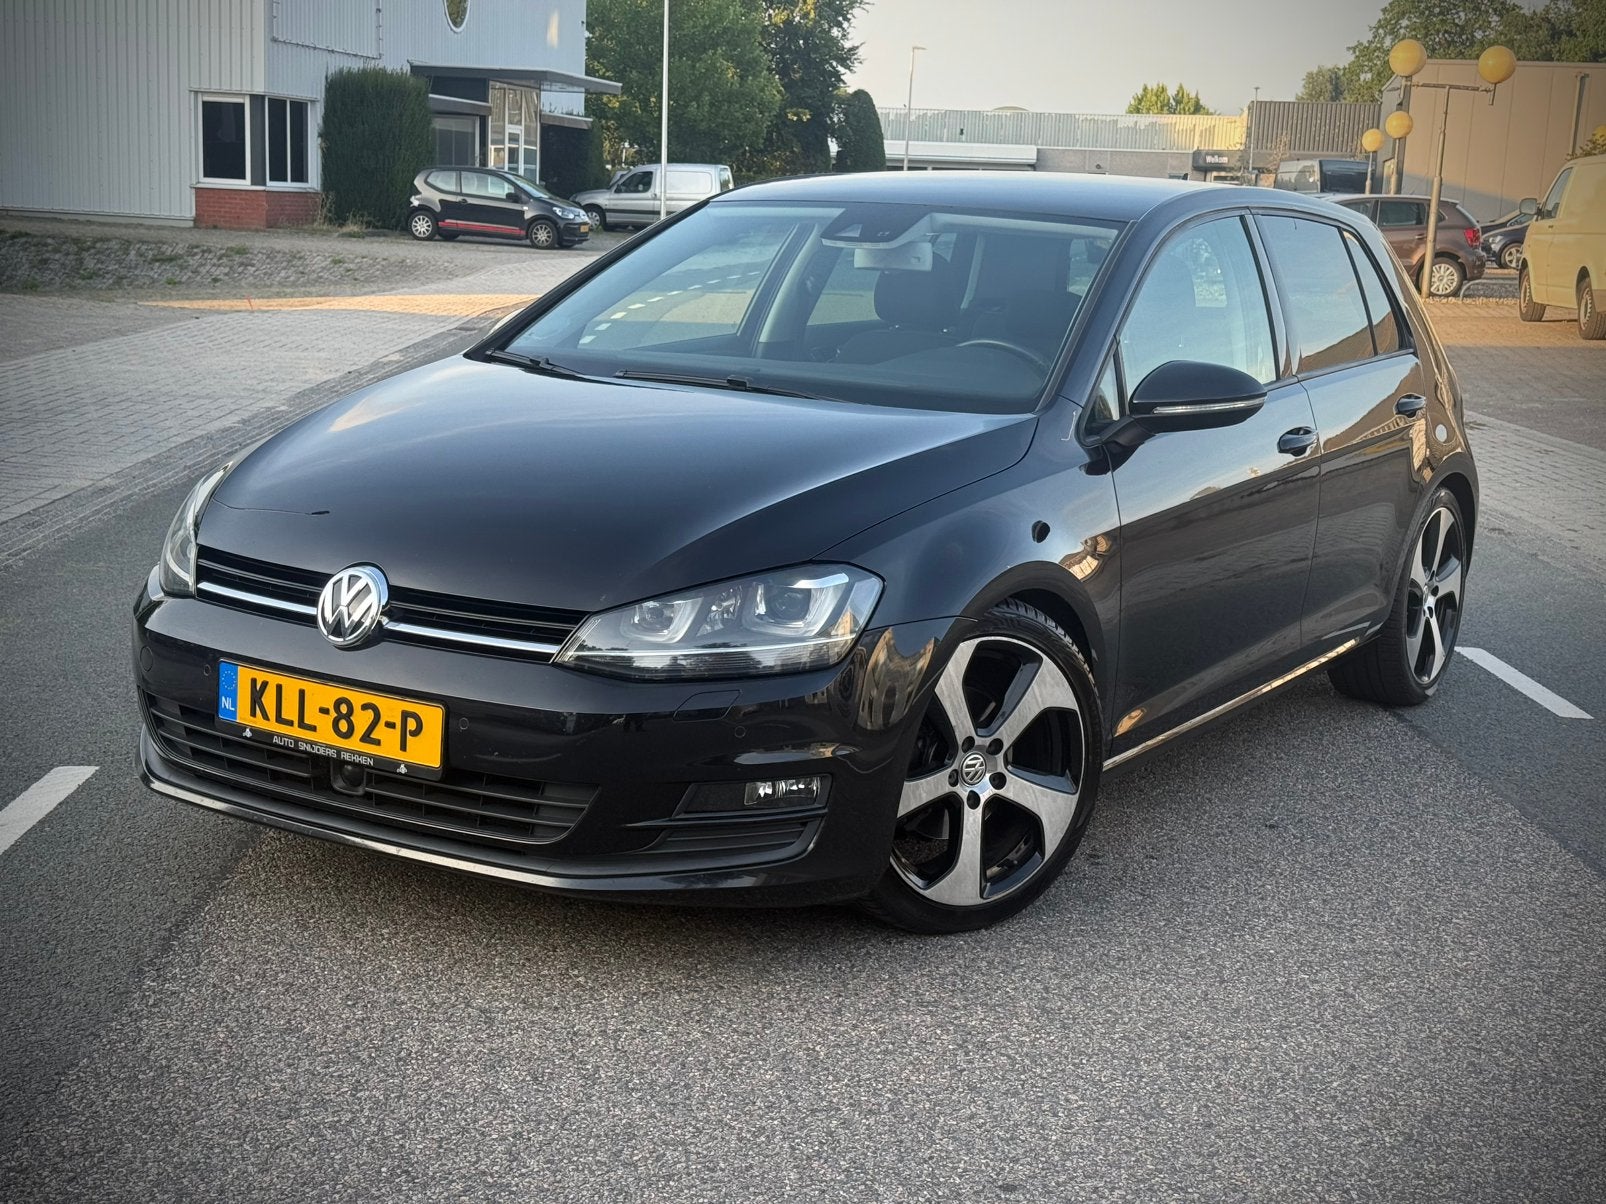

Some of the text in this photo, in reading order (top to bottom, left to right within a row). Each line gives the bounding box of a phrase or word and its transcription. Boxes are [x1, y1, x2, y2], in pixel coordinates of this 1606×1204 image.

[221, 695, 235, 711] NL
[249, 677, 424, 752] KLL-82-P
[272, 735, 374, 766] AUTO SNIJDERS REKKEN
